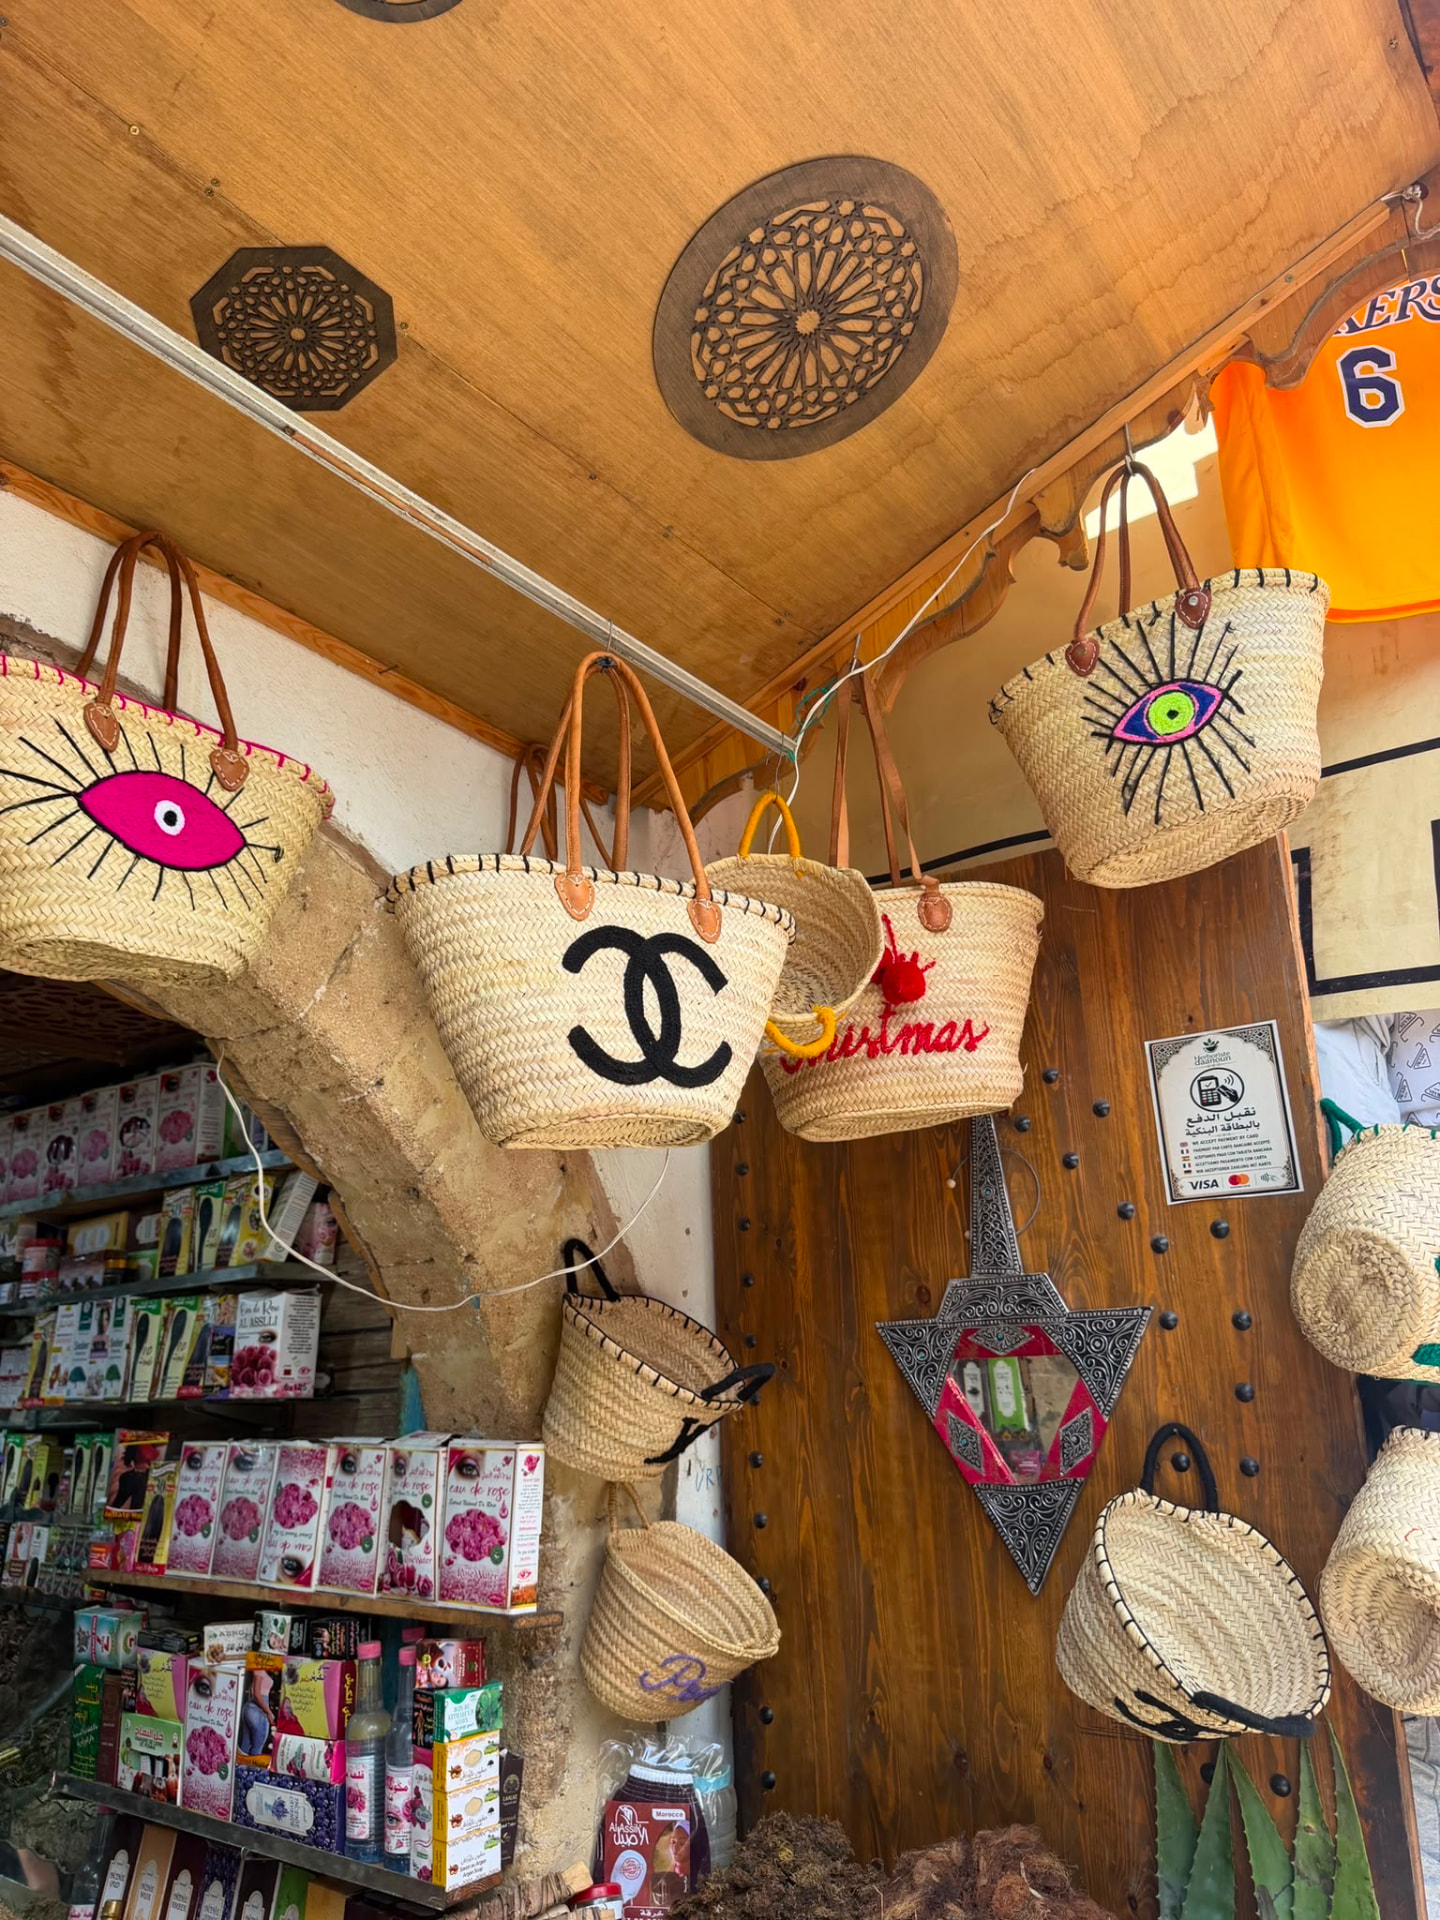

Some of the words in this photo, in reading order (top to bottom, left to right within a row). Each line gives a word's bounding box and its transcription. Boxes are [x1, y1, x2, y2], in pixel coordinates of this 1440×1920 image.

[1336, 345, 1405, 428] 6
[1194, 1051, 1230, 1061] Herboriste
[1186, 1113, 1220, 1127] الدفع
[1224, 1107, 1256, 1121] نقبل
[1185, 1126, 1217, 1137] البنكية
[1221, 1120, 1260, 1132] بالبطاقة
[1189, 1179, 1219, 1190] VISA
